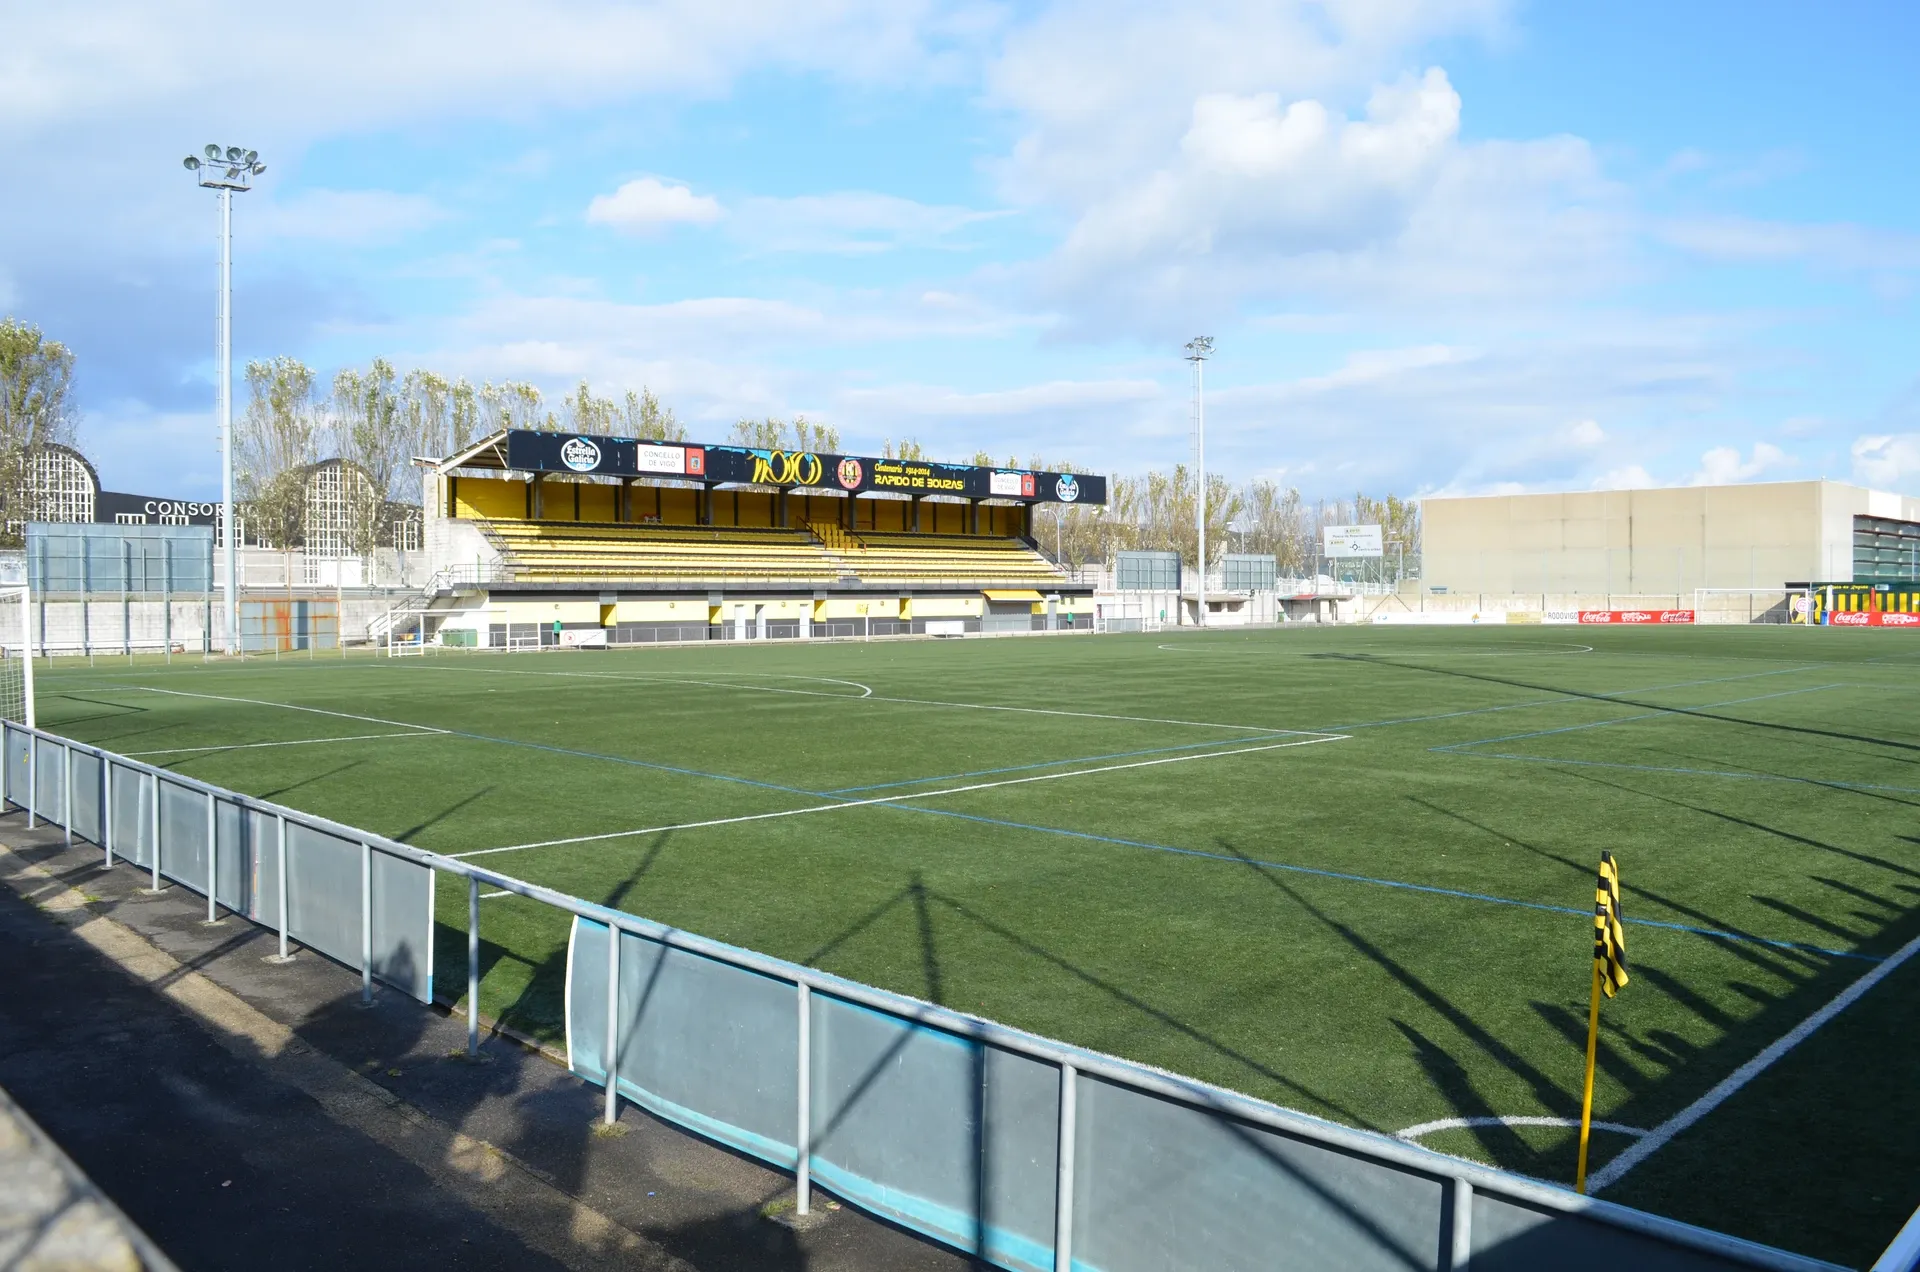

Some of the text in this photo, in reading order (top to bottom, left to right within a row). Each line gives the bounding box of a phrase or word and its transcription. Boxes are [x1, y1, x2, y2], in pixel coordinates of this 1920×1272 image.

[566, 445, 596, 456] Estrella
[643, 450, 681, 460] CONCELLO
[567, 454, 595, 464] Galicia
[660, 460, 676, 468] VIGO
[874, 463, 930, 477] Centenario 1914-2014
[874, 475, 964, 490] RAPIDO DE BOUZAS
[1582, 612, 1611, 623] Coca-Cola
[1834, 612, 1870, 624] Coca-Cola
